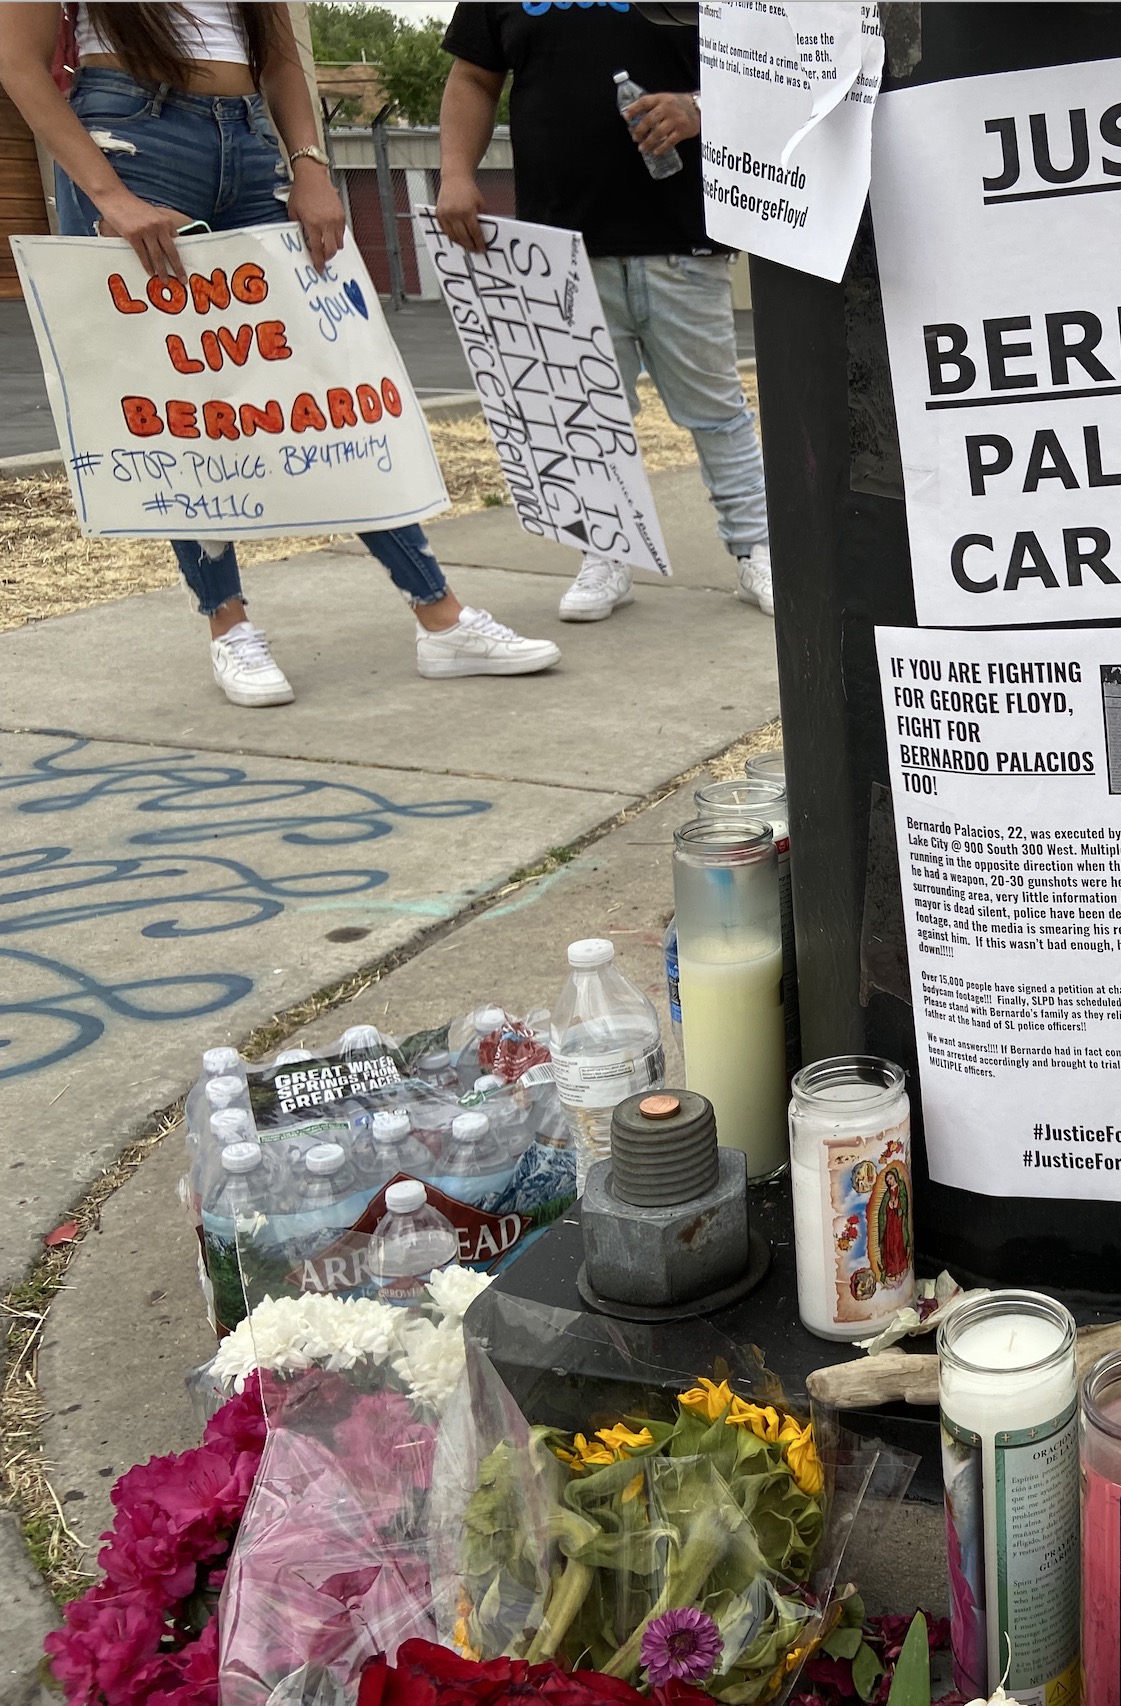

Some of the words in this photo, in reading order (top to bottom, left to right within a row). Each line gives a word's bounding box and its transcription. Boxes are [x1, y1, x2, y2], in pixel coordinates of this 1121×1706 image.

[820, 33, 834, 45] the
[718, 41, 728, 54] fact
[730, 46, 767, 63] committed
[769, 56, 774, 65] a
[776, 56, 798, 71] crime
[816, 51, 832, 62] 8th.
[726, 60, 741, 75] trial,
[743, 64, 772, 83] instead,
[774, 71, 784, 84] he
[786, 76, 800, 88] was
[821, 67, 837, 80] and
[108, 262, 269, 315] LONG
[165, 320, 292, 374] LIVE
[510, 239, 611, 481] SILENCE
[581, 497, 630, 554] IS
[572, 326, 637, 457] YOUR
[121, 377, 402, 441] BERNARDO
[143, 491, 264, 519] #84116
[890, 657, 904, 678] IF
[909, 658, 942, 681] YOU
[948, 661, 981, 684] ARE
[987, 661, 1082, 684] FIGHTING
[894, 686, 925, 709] FOR
[930, 689, 1000, 714] GEORGE
[1005, 692, 1074, 717] FLOYD,
[897, 715, 942, 740] FIGHT
[947, 720, 981, 743] FOR
[900, 744, 989, 772] BERNARDO
[996, 751, 1095, 772] PALACIOS
[902, 772, 938, 796] TOO!
[906, 816, 951, 835] Bernardo
[954, 822, 1004, 841] Palacios,
[1007, 826, 1027, 841] 22,
[1030, 830, 1051, 839] was
[1054, 827, 1105, 839] executed
[1108, 827, 1121, 841] by
[908, 833, 928, 847] Lake
[930, 836, 948, 852] City
[951, 839, 962, 853] @
[964, 841, 984, 854] 900
[986, 842, 1018, 855] South
[1021, 843, 1043, 856] 300
[1046, 843, 1077, 855] West.
[909, 851, 944, 867] running
[945, 854, 954, 866] in
[956, 856, 972, 869] the
[974, 859, 1020, 873] opposite
[1023, 859, 1073, 872] direction
[1076, 859, 1105, 872] when
[921, 970, 938, 982] Over
[938, 974, 964, 987] 15,000
[965, 981, 992, 992] people
[994, 982, 1015, 993] have
[1017, 983, 1047, 995] signed
[1058, 984, 1094, 995] petition
[1096, 985, 1106, 994] at
[274, 1065, 343, 1089] GREAT
[348, 1055, 395, 1074] WATER
[277, 1073, 358, 1100] SPRINGS
[363, 1066, 398, 1081] FROM
[280, 1086, 344, 1114] GREAT
[300, 1213, 522, 1292] ARREAD
